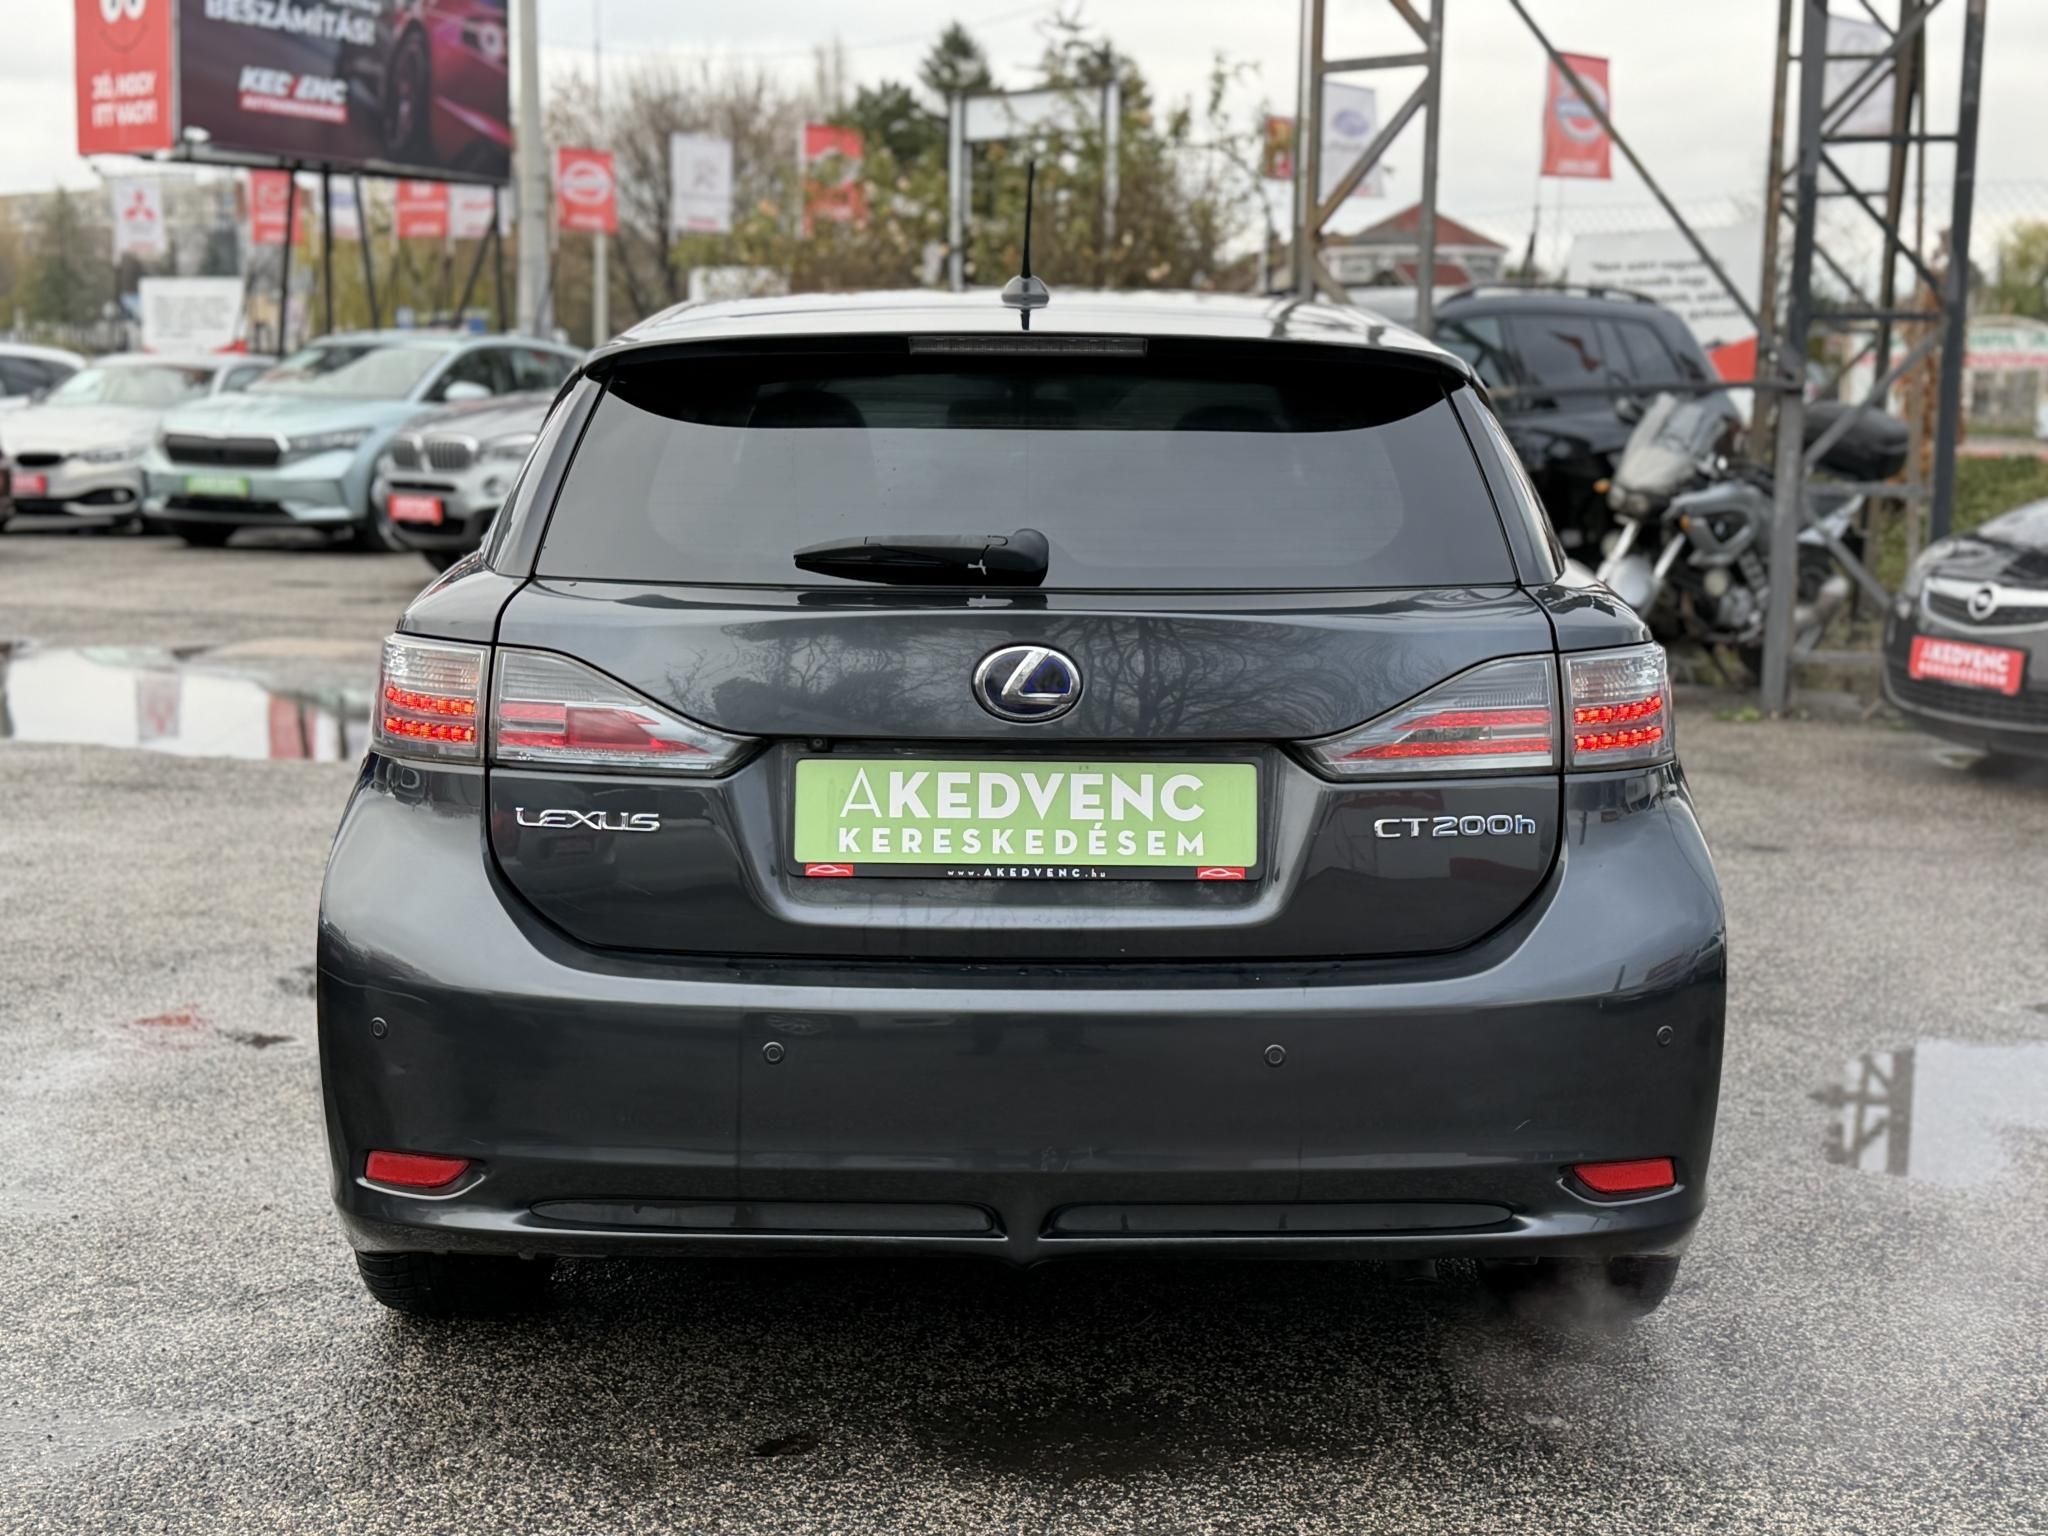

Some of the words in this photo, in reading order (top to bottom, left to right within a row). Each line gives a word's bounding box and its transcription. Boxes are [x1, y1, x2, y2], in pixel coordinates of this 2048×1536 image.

[515, 807, 661, 832] LEXUS
[837, 822, 1206, 857] KERESKEDÉSEM
[946, 866, 1106, 879] www.AKEDVENC.hu
